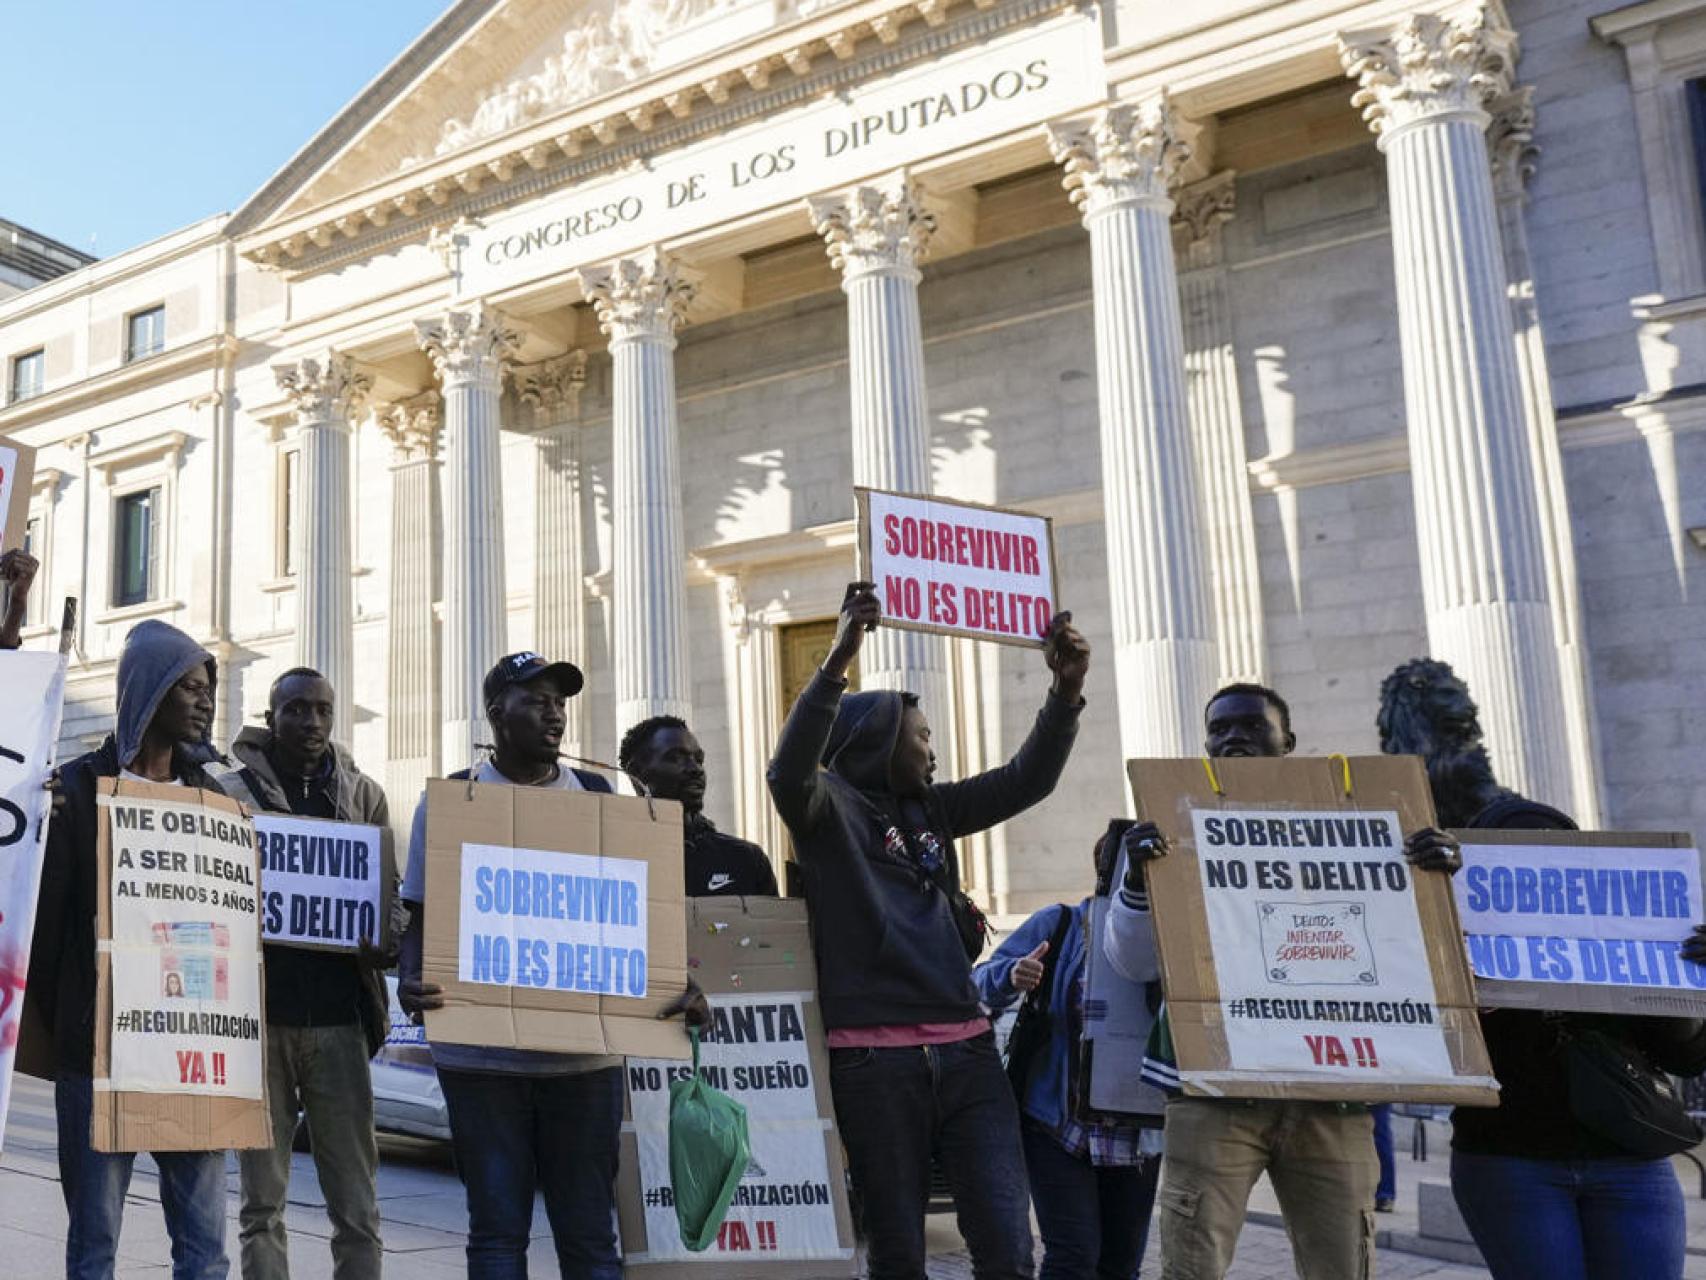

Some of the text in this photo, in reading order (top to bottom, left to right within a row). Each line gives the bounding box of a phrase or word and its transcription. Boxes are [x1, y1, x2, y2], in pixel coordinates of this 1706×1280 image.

[485, 60, 1049, 265] CONGRESO DE LOS DIPUTADOS
[884, 513, 1040, 575] SOBREVIVIR
[885, 575, 1051, 638] NO ES DELITO
[116, 807, 253, 849] ME OBLIGAN
[1204, 817, 1393, 848] SOBREVIVIR
[118, 848, 254, 886] A SER ILEGAL
[1205, 859, 1407, 892] NO ES DELITO
[117, 881, 256, 914] AL MENOS 3 AÑOS
[475, 866, 638, 927] SOBREVIVIR
[1466, 865, 1690, 919] SOBREVIVIR
[261, 892, 284, 934] S
[289, 893, 375, 943] DELITO
[1276, 944, 1357, 962] SOBREVIVIR
[1287, 930, 1344, 944] INTENTAR
[472, 934, 645, 996] NO ES DELITO
[1467, 934, 1521, 978] NO
[1525, 936, 1574, 980] ES
[117, 1008, 259, 1041] #REGULARIZACIÓN
[1228, 998, 1434, 1025] #REGULARIZACIÓN
[176, 1050, 226, 1085] YA !!
[1304, 1035, 1380, 1068] YA !!
[630, 1066, 661, 1092] NO
[699, 1065, 729, 1091] MI
[733, 1060, 809, 1091] SUEÑO
[645, 1180, 830, 1207] #RRIZACIÓN
[755, 1220, 777, 1249] !!
